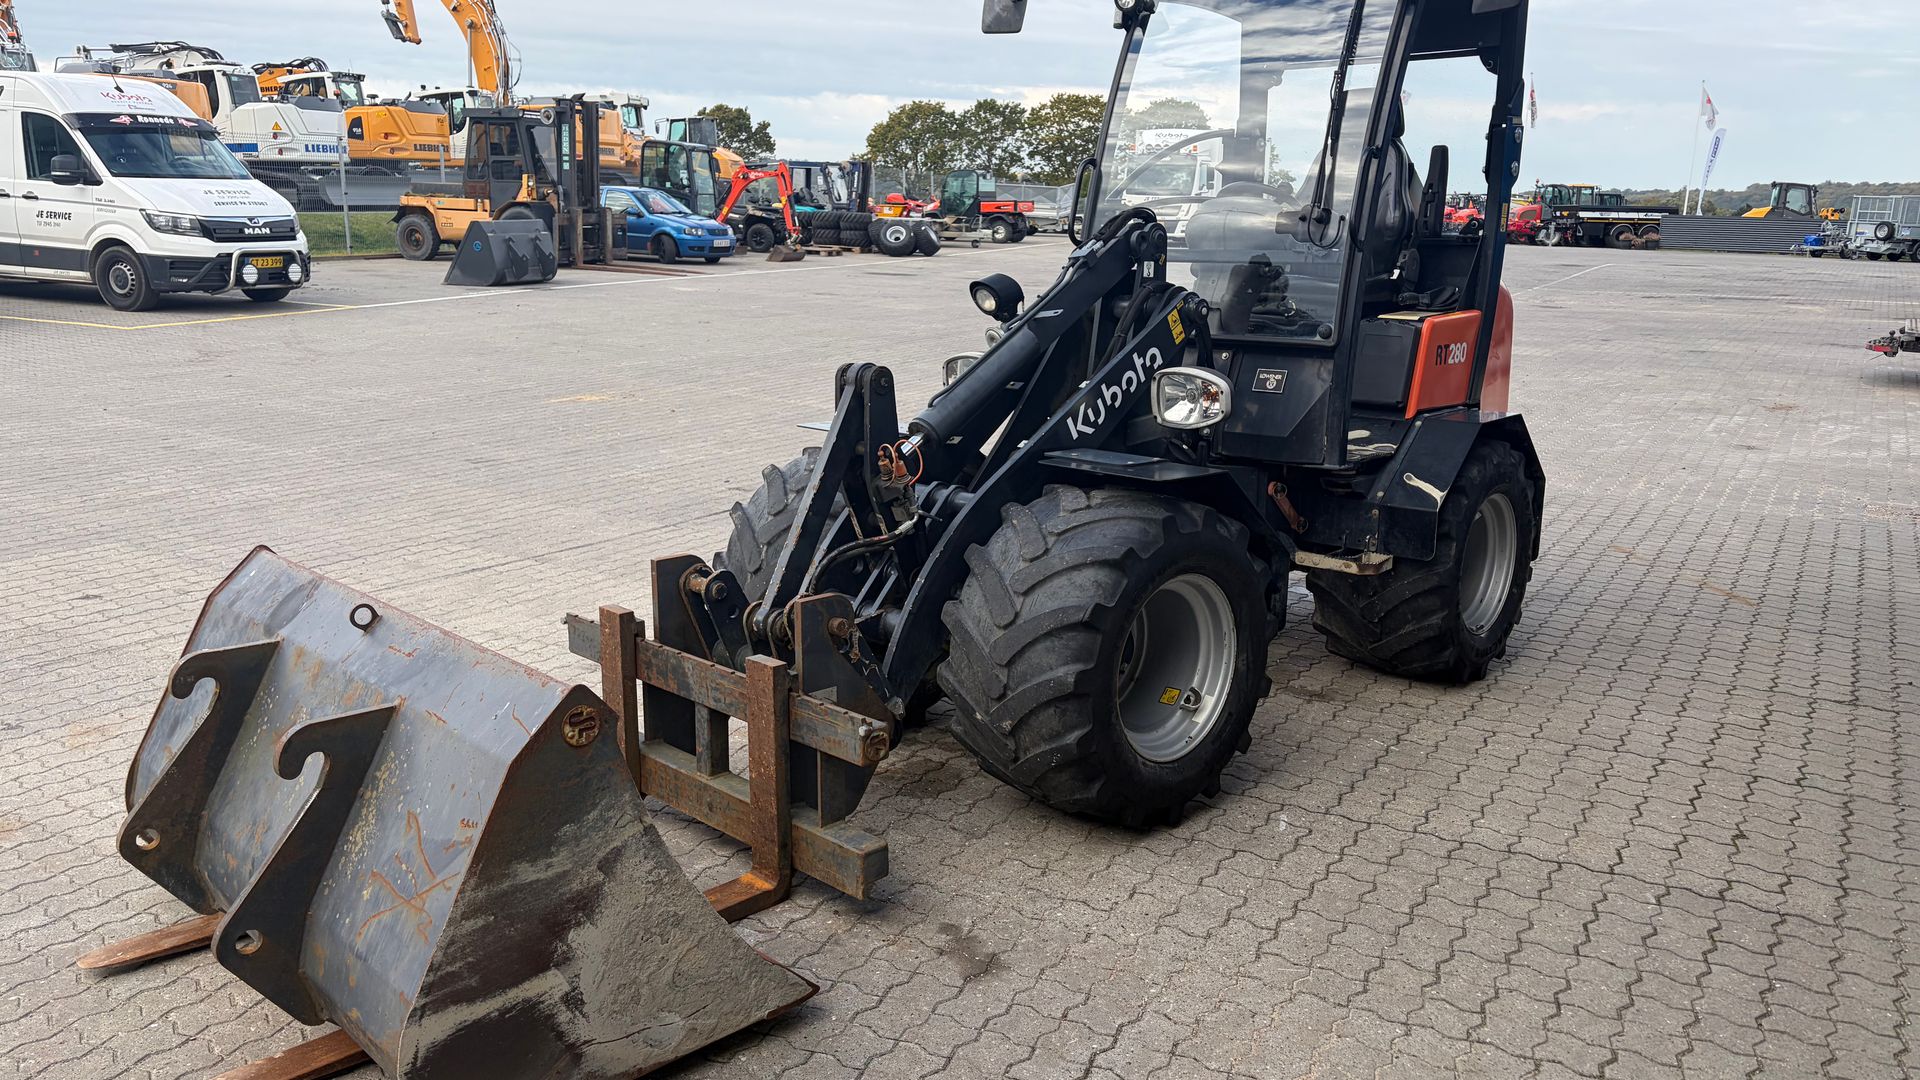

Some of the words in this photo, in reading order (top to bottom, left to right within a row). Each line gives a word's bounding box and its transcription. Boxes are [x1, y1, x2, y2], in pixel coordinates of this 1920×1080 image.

[36, 210, 44, 219] JE
[45, 210, 72, 221] SERVICE
[244, 227, 271, 235] MAN
[260, 258, 269, 267] 23
[1435, 342, 1467, 366] RT280
[1066, 347, 1164, 440] Kubota
